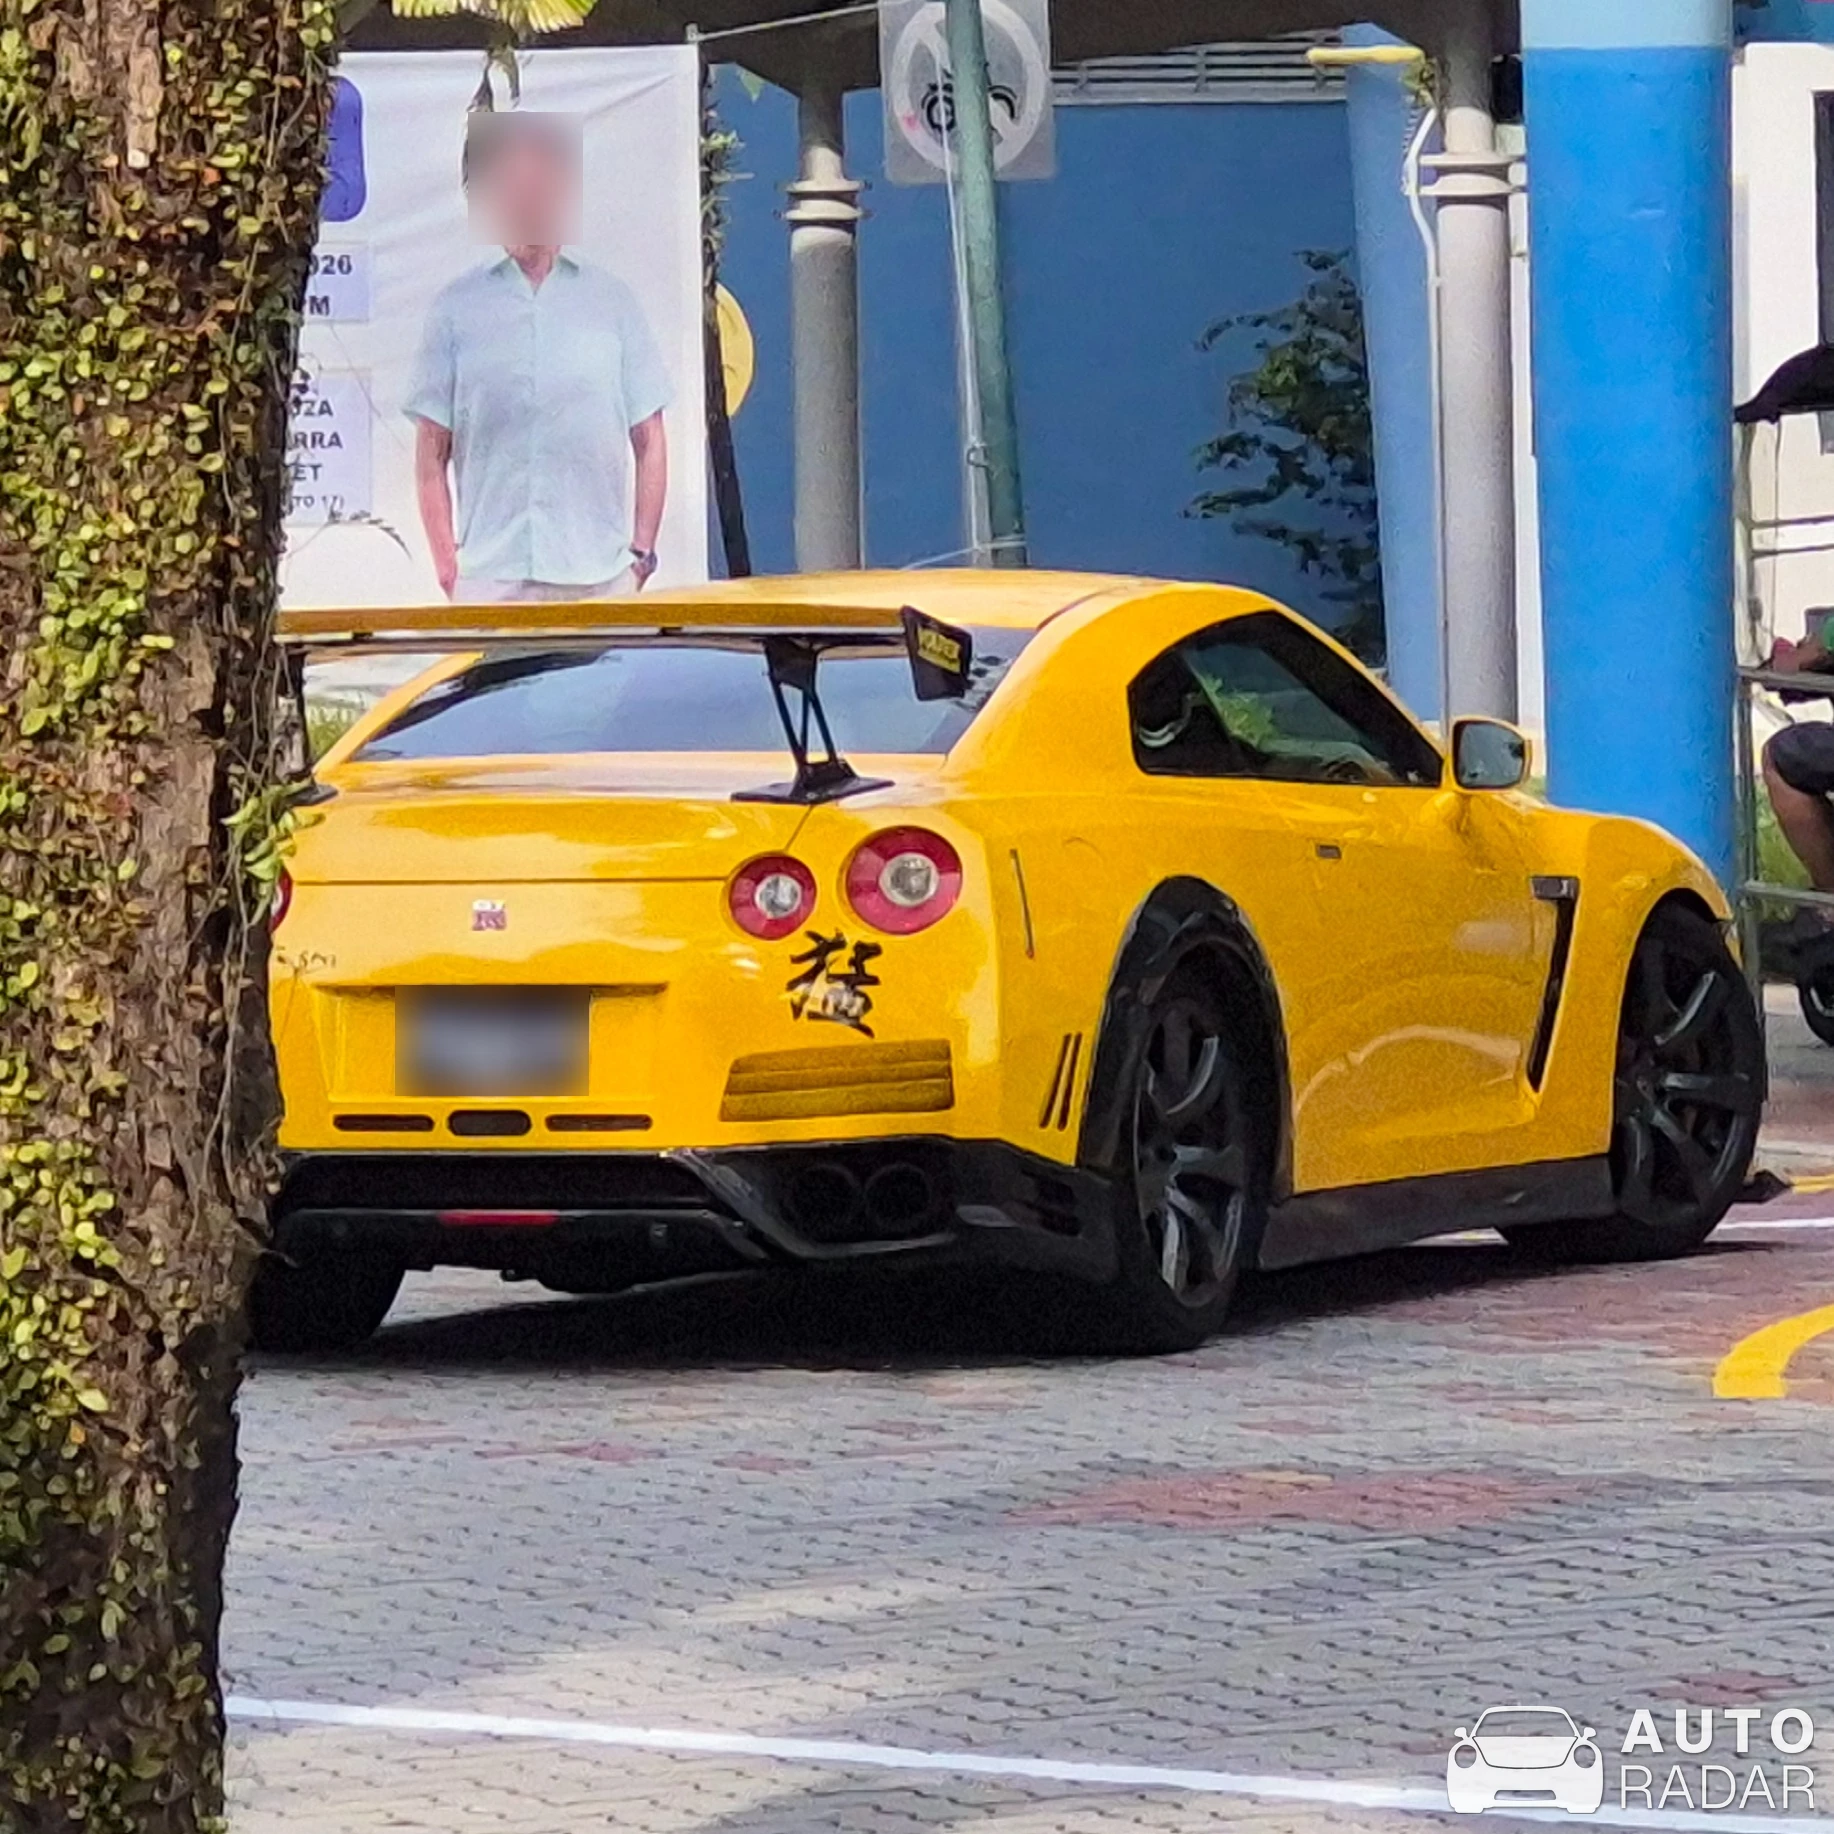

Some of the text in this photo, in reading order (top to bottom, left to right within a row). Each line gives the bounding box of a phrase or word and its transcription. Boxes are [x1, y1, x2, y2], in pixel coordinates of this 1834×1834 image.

[308, 254, 352, 275] 026
[309, 295, 330, 316] M
[294, 431, 343, 449] RRA
[292, 463, 323, 481] ET
